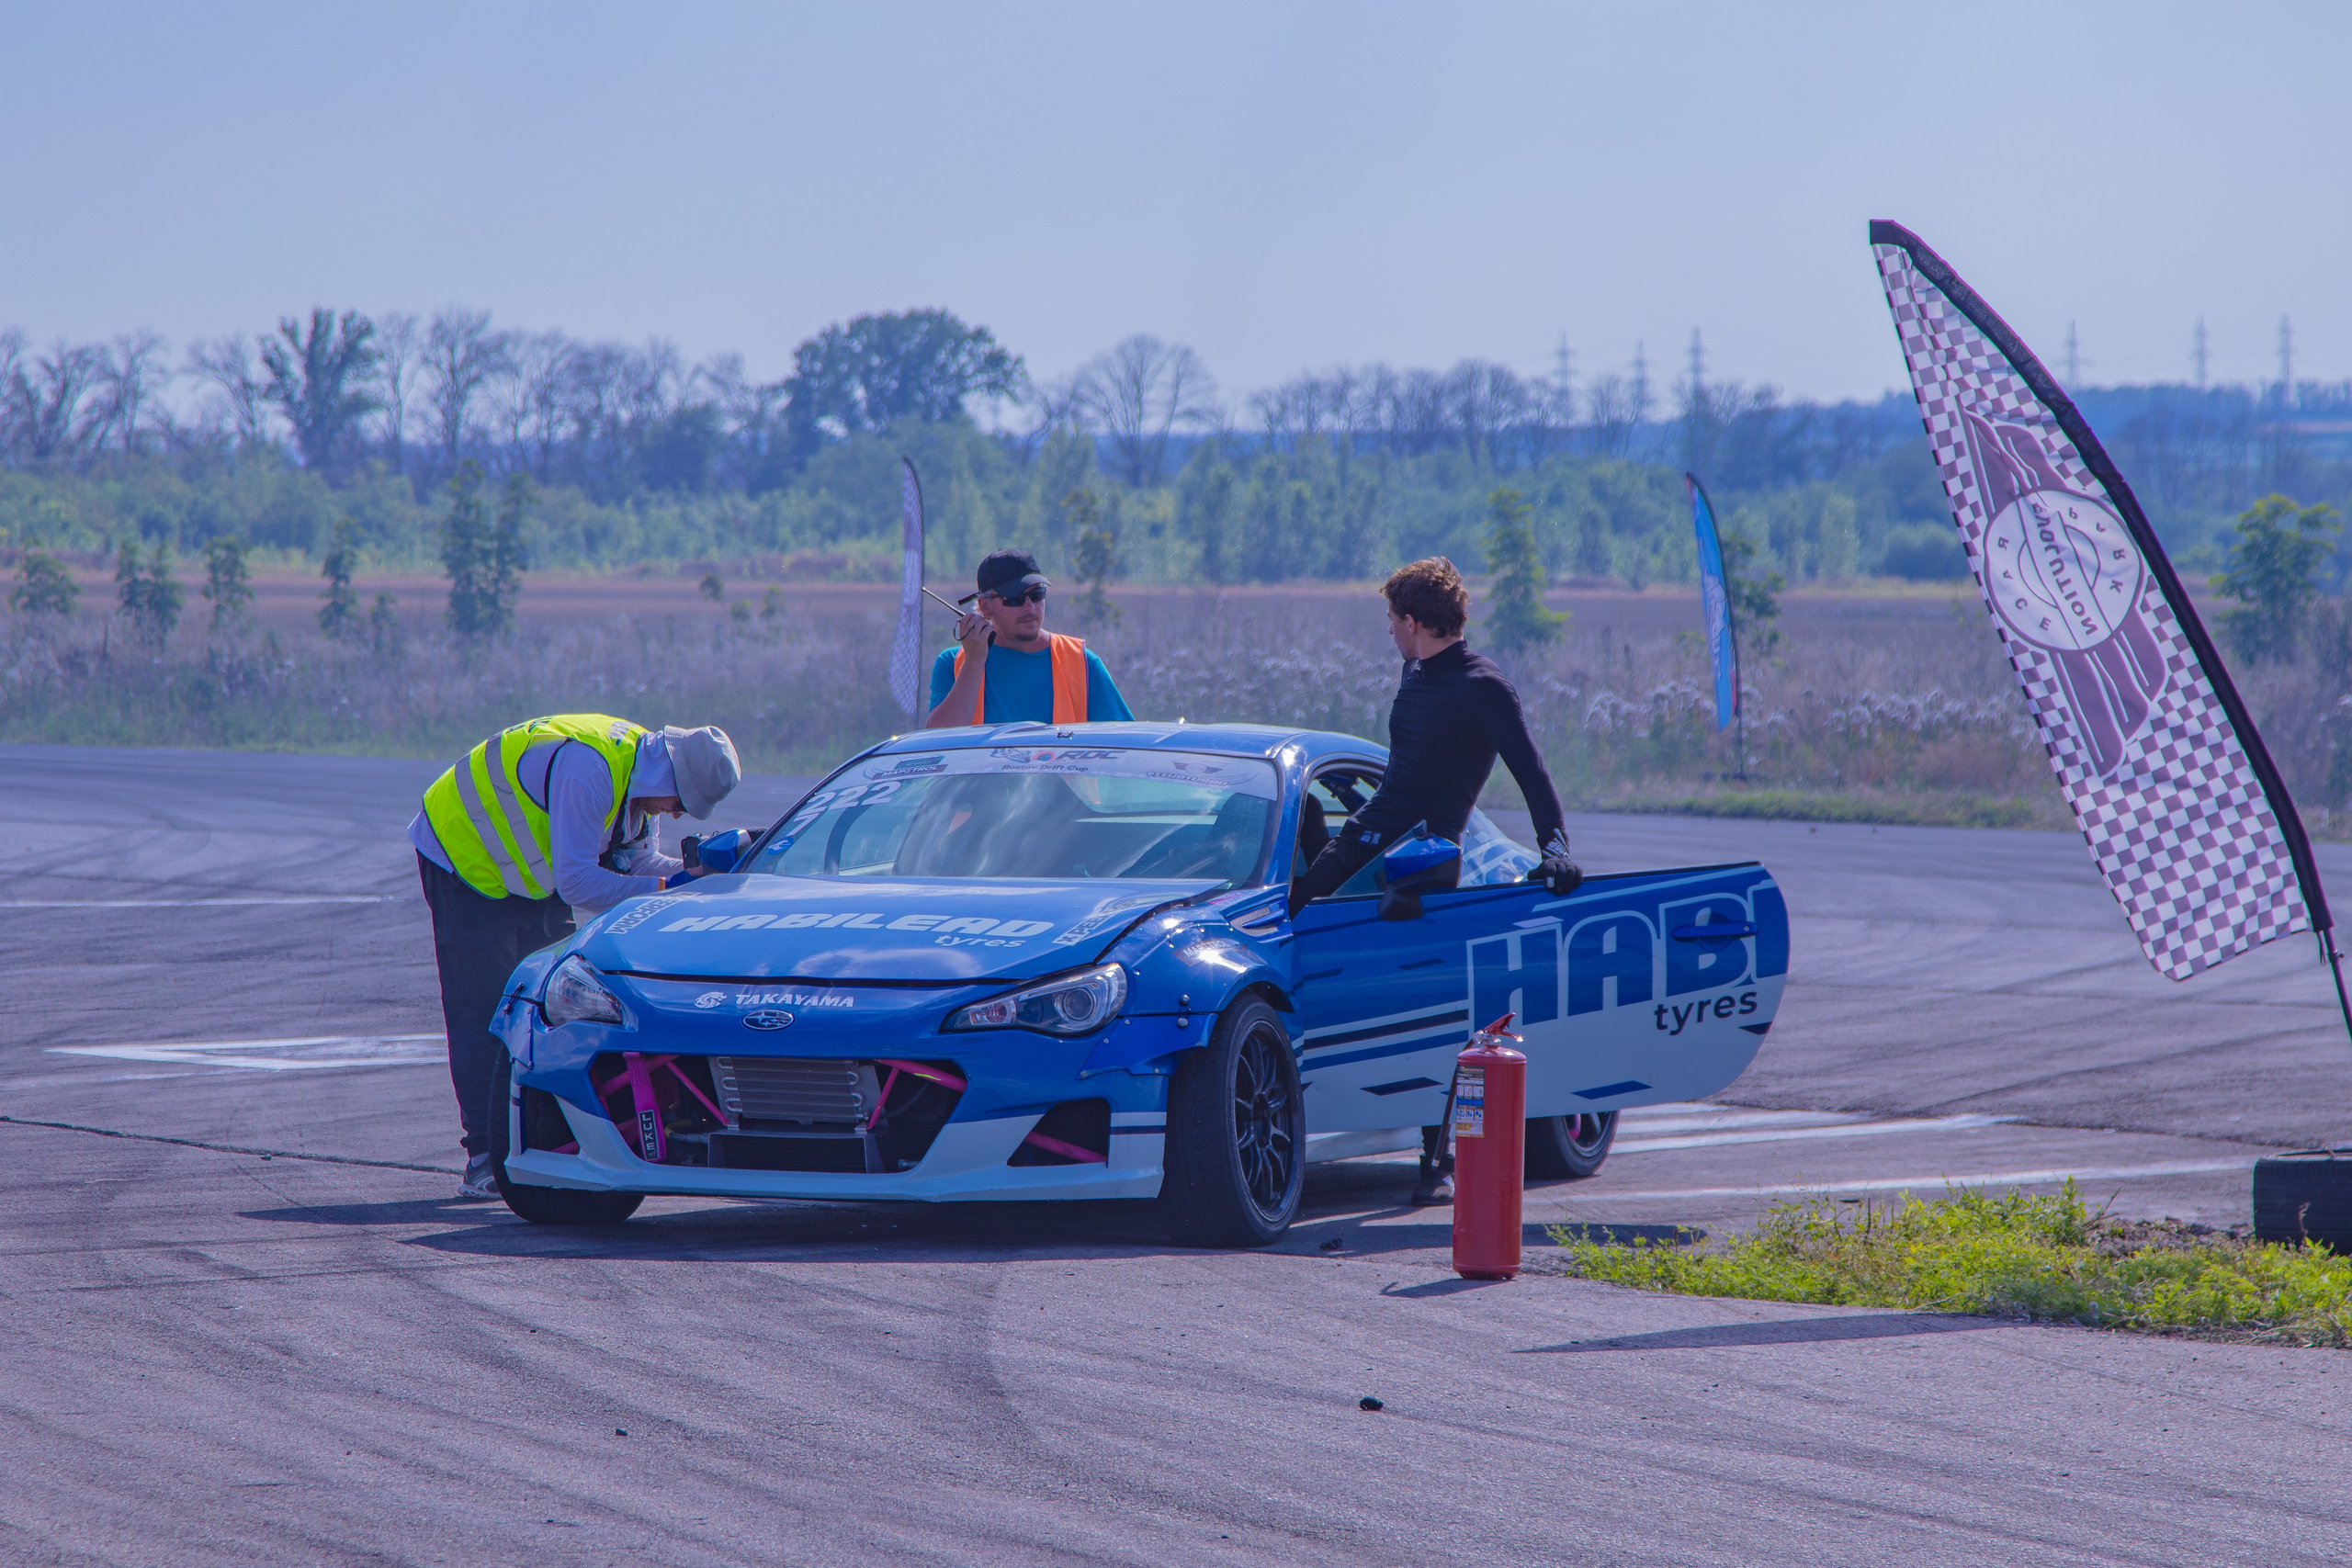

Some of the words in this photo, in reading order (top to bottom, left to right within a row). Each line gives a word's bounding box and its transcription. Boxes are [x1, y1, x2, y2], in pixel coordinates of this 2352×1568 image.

[1056, 750, 1127, 760] RDC
[797, 781, 901, 817] 222
[657, 913, 1054, 937] HABILEAD
[934, 934, 1027, 948] tyres
[736, 994, 854, 1008] TAKAYAMA
[1654, 991, 1758, 1035] tyres
[641, 1113, 655, 1151] LUKE
